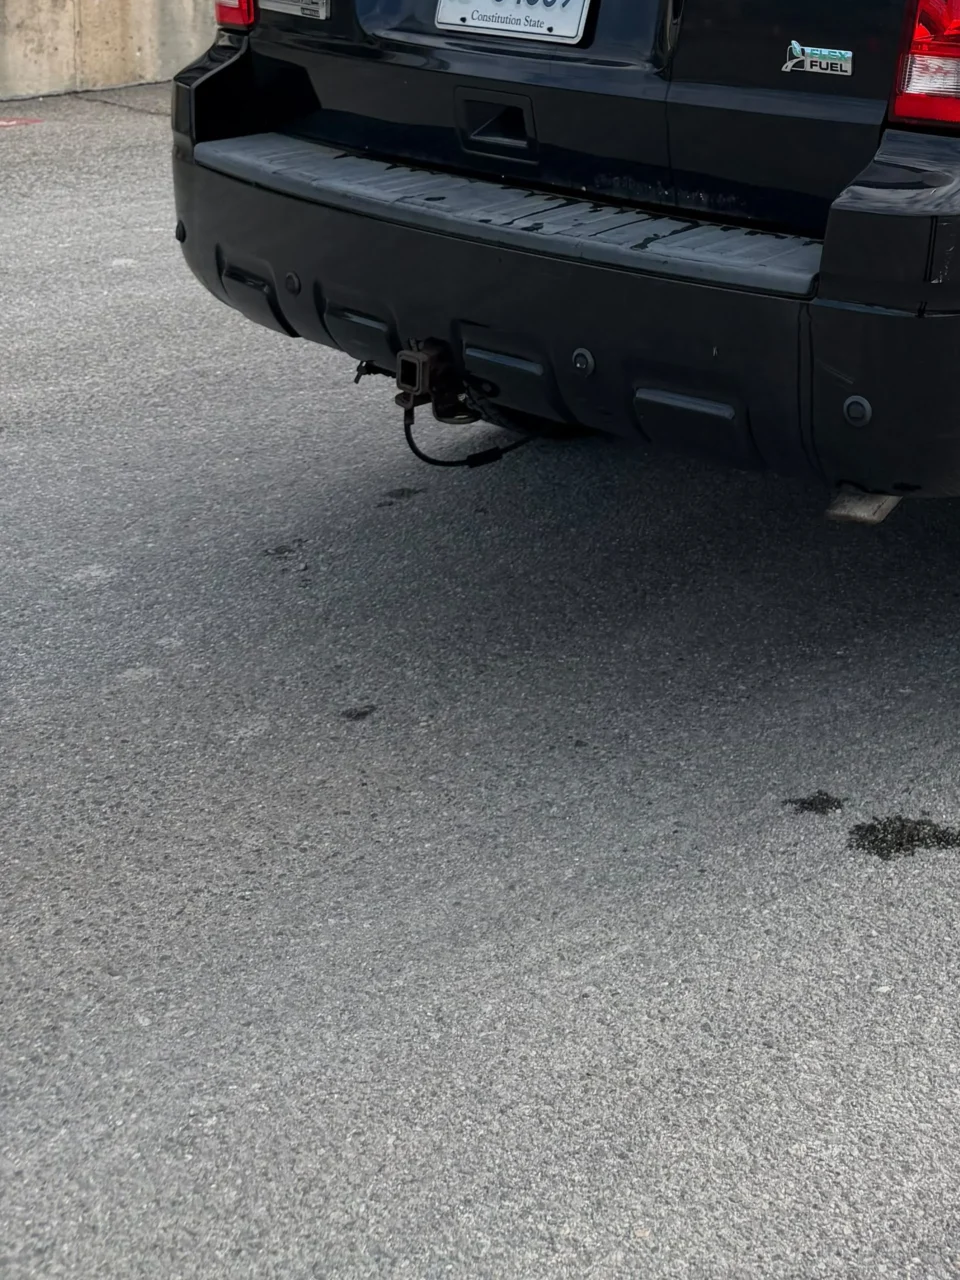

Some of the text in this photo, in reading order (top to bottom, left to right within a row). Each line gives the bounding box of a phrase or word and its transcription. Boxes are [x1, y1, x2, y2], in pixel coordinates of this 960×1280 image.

[471, 9, 545, 29] Constitution State
[809, 48, 848, 61] FLEX
[809, 60, 848, 73] FUEL
